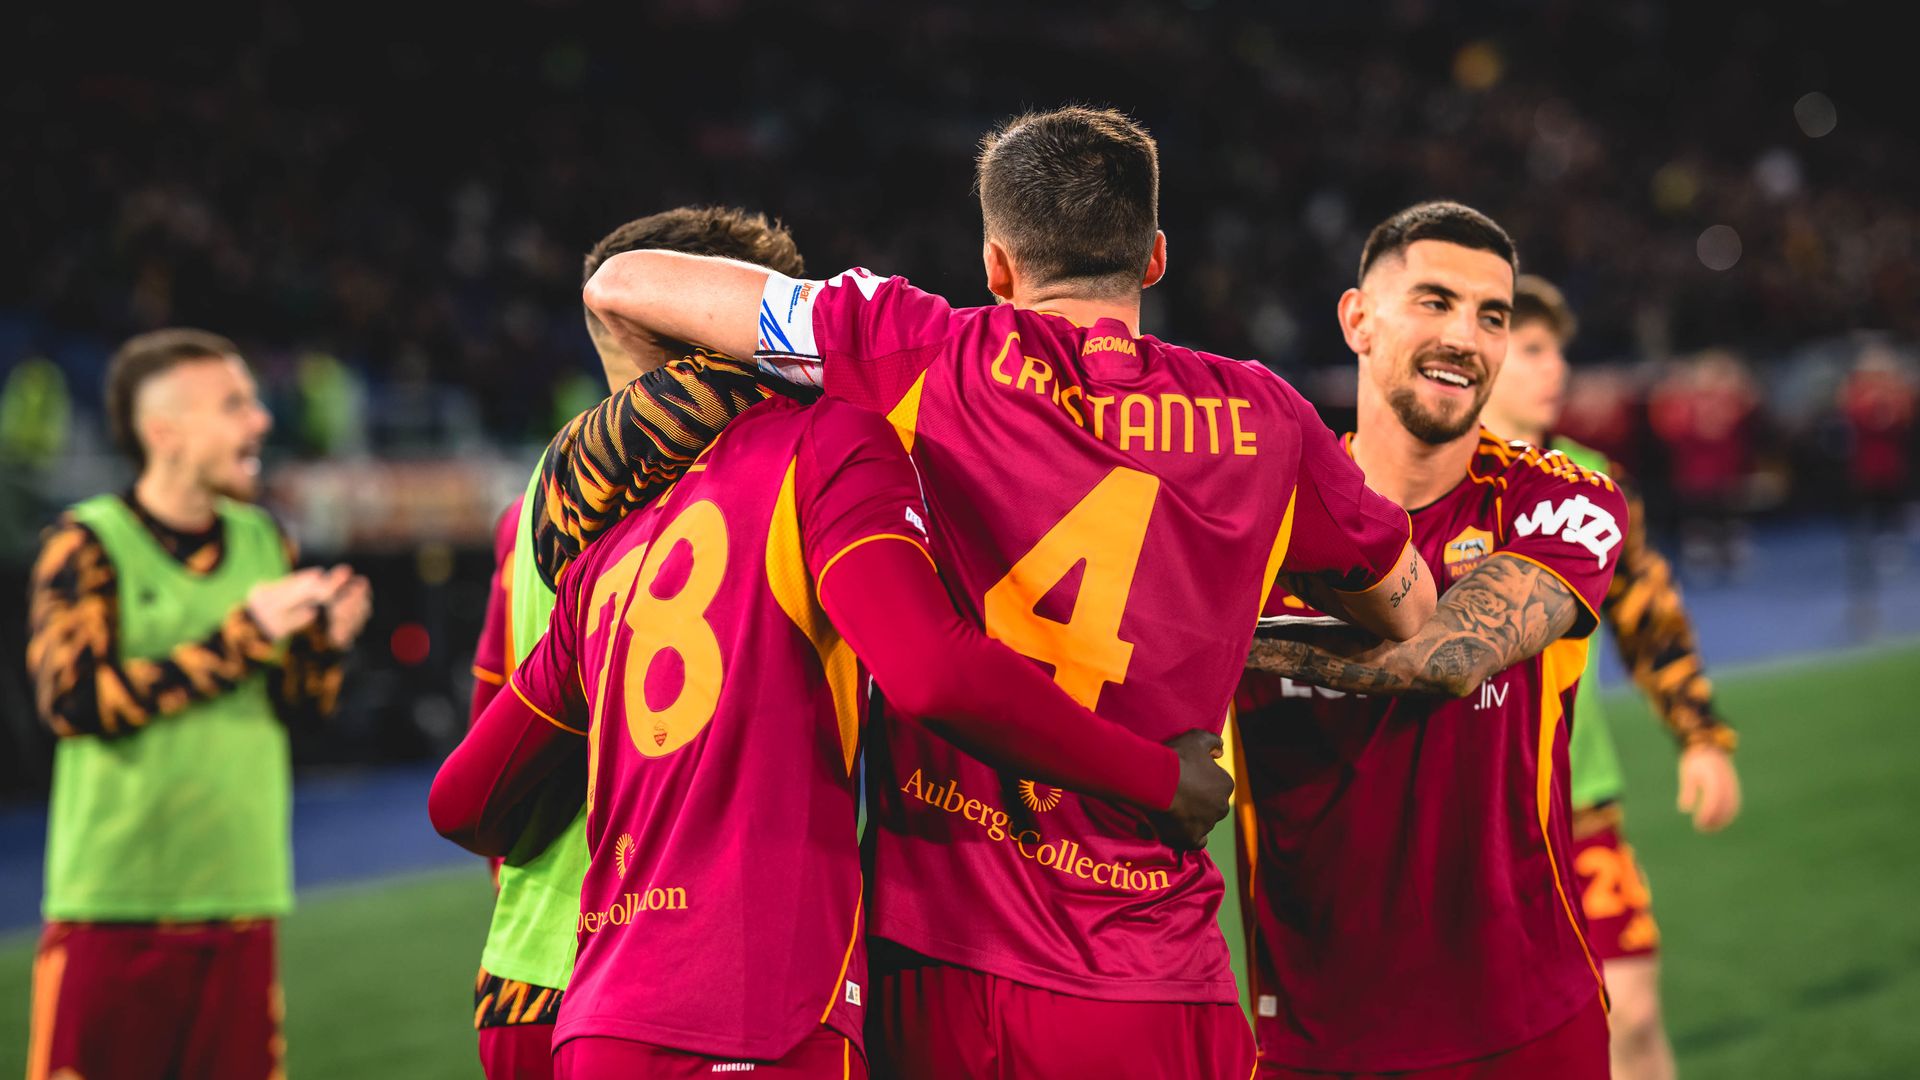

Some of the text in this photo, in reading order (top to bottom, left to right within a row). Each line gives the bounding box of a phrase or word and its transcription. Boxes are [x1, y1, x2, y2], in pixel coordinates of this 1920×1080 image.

[1082, 336, 1137, 357] ASROMA
[984, 466, 1160, 713] 4
[586, 499, 728, 816] 78
[1017, 830, 1171, 891] Collection
[711, 1062, 755, 1073] AEROREADY
